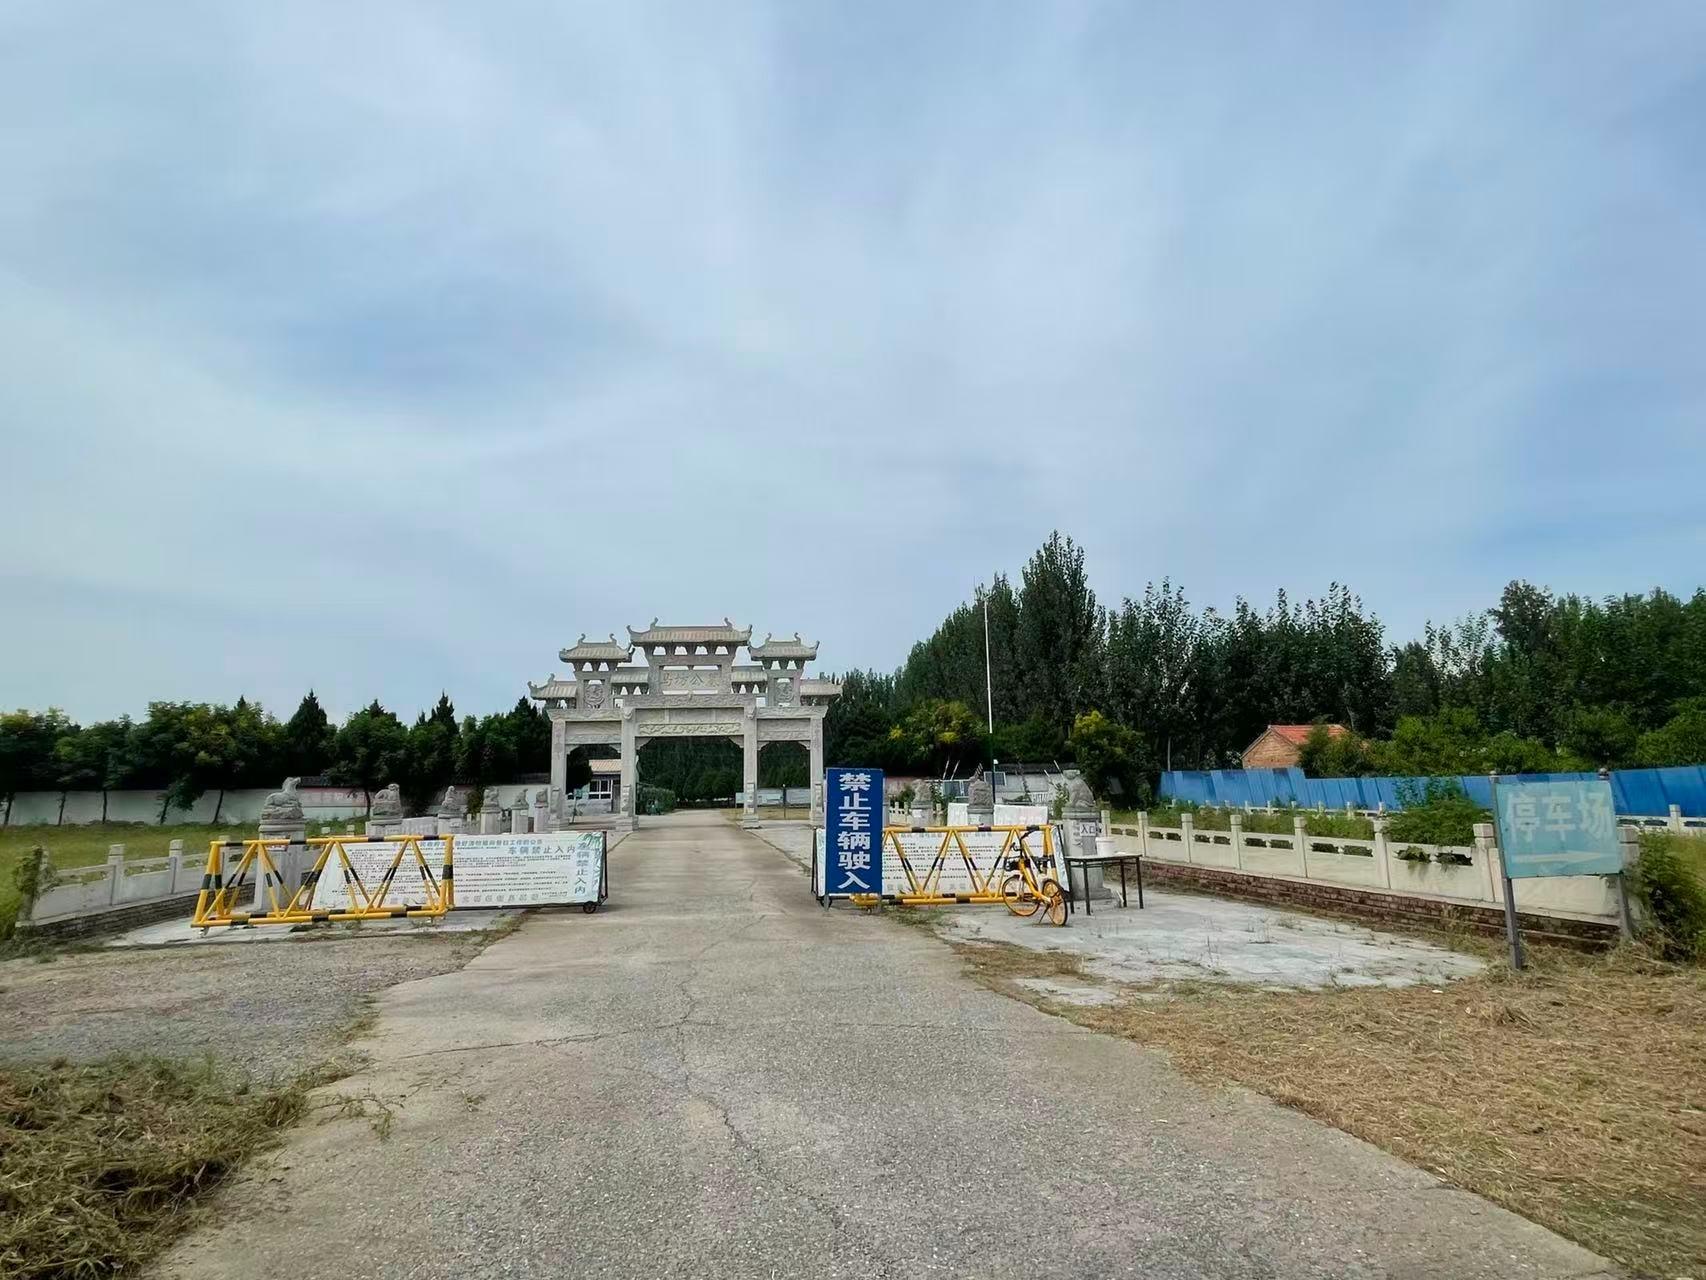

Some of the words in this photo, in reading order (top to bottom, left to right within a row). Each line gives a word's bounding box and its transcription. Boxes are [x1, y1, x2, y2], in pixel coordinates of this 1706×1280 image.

[838, 773, 871, 889] 禁止车辆驶入
[1081, 823, 1095, 834] 入口
[1507, 790, 1613, 843] 停车场
